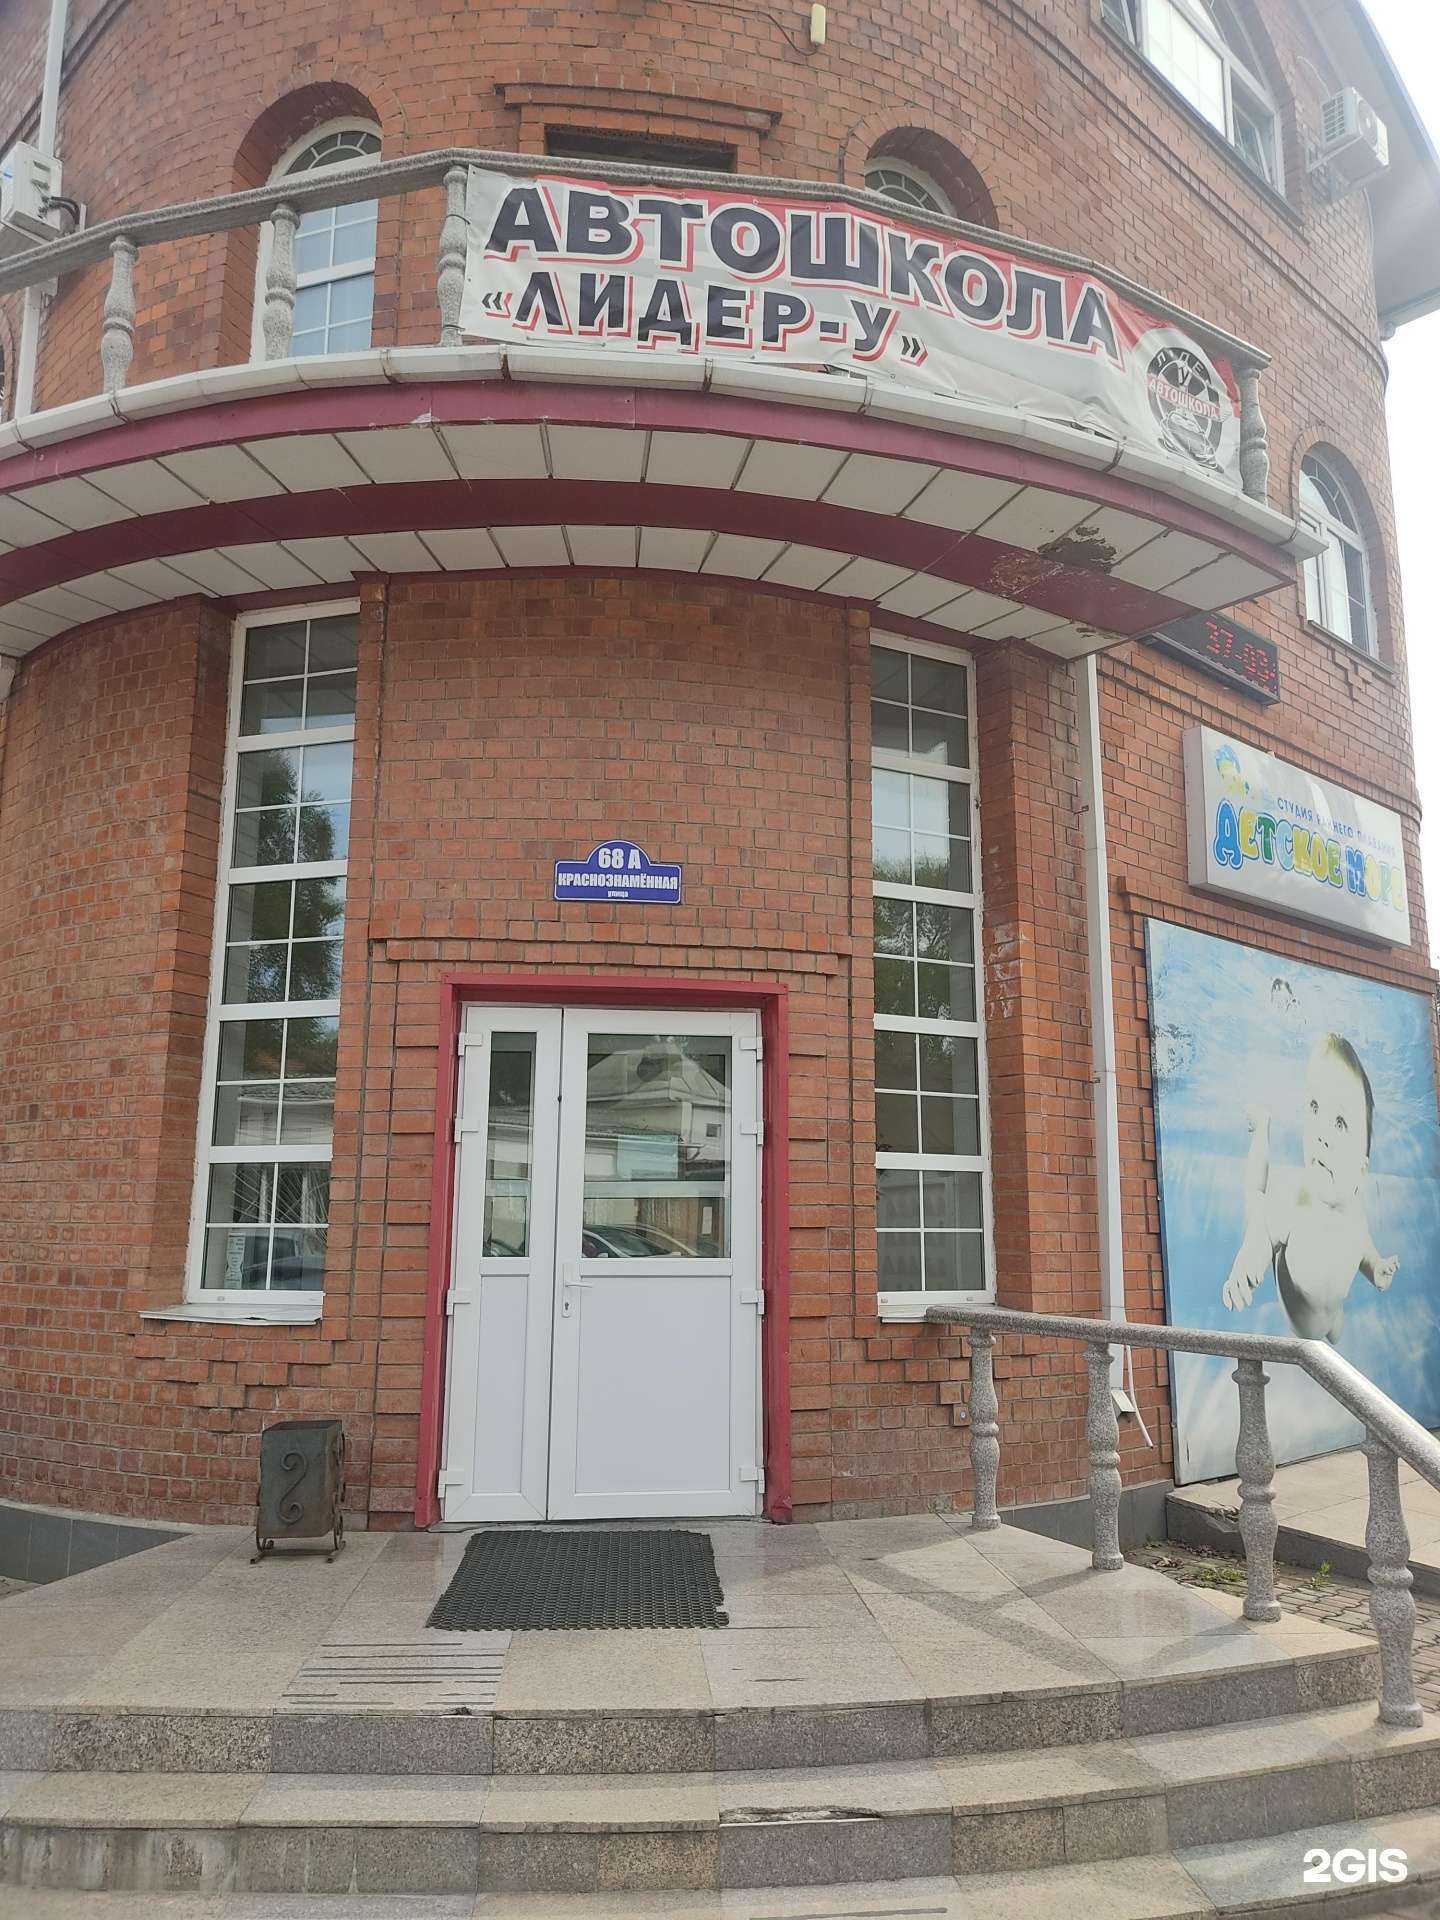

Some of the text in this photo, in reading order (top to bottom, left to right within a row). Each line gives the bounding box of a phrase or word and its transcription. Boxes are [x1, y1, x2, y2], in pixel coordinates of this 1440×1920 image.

[483, 186, 1121, 366] АВТОШКОЛА
[481, 271, 925, 361] «ЛИДЕР-У»
[1149, 378, 1217, 418] АВТОШКОЛА
[1277, 797, 1313, 821] СТУДИЯ
[598, 847, 641, 870] 68 А
[1213, 799, 1343, 888] ДЕТСКОЕ
[557, 872, 678, 890] КРАСНОЗНАМЁННАЯ
[607, 889, 629, 898] улица
